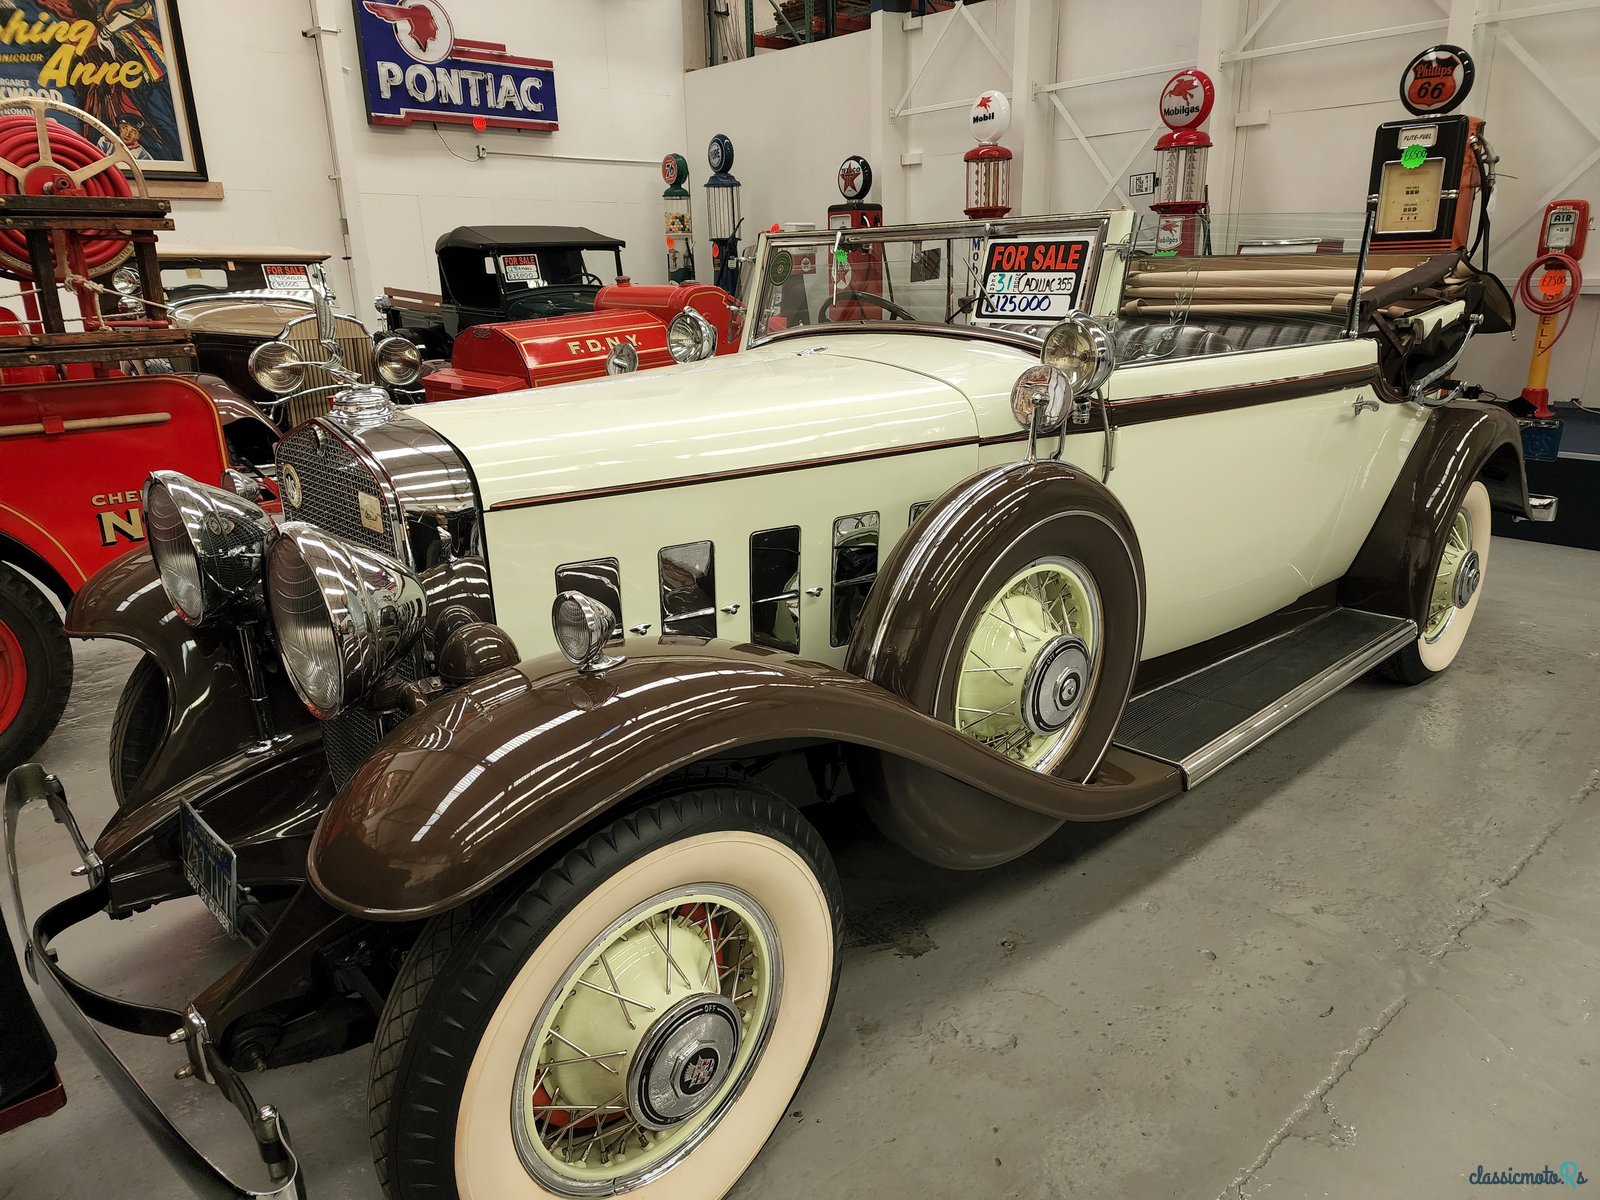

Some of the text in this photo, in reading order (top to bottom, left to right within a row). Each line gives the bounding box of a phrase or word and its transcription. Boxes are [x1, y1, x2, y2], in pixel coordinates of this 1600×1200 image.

[0, 8, 96, 56] hing
[0, 52, 44, 63] NICOLOR
[37, 43, 143, 89] Anne
[1416, 65, 1454, 78] Phillips
[376, 60, 544, 113] PONTIAC
[1417, 81, 1446, 99] 66
[1163, 105, 1200, 117] Mobilgas
[972, 112, 995, 124] Mobil
[1553, 214, 1573, 222] AIR
[504, 256, 535, 266] FOR SALE
[991, 244, 1083, 271] FOR SALE
[266, 266, 306, 275] FOR SALE
[995, 272, 1013, 293] 31
[1055, 277, 1074, 291] 355
[704, 1004, 717, 1012] OFF
